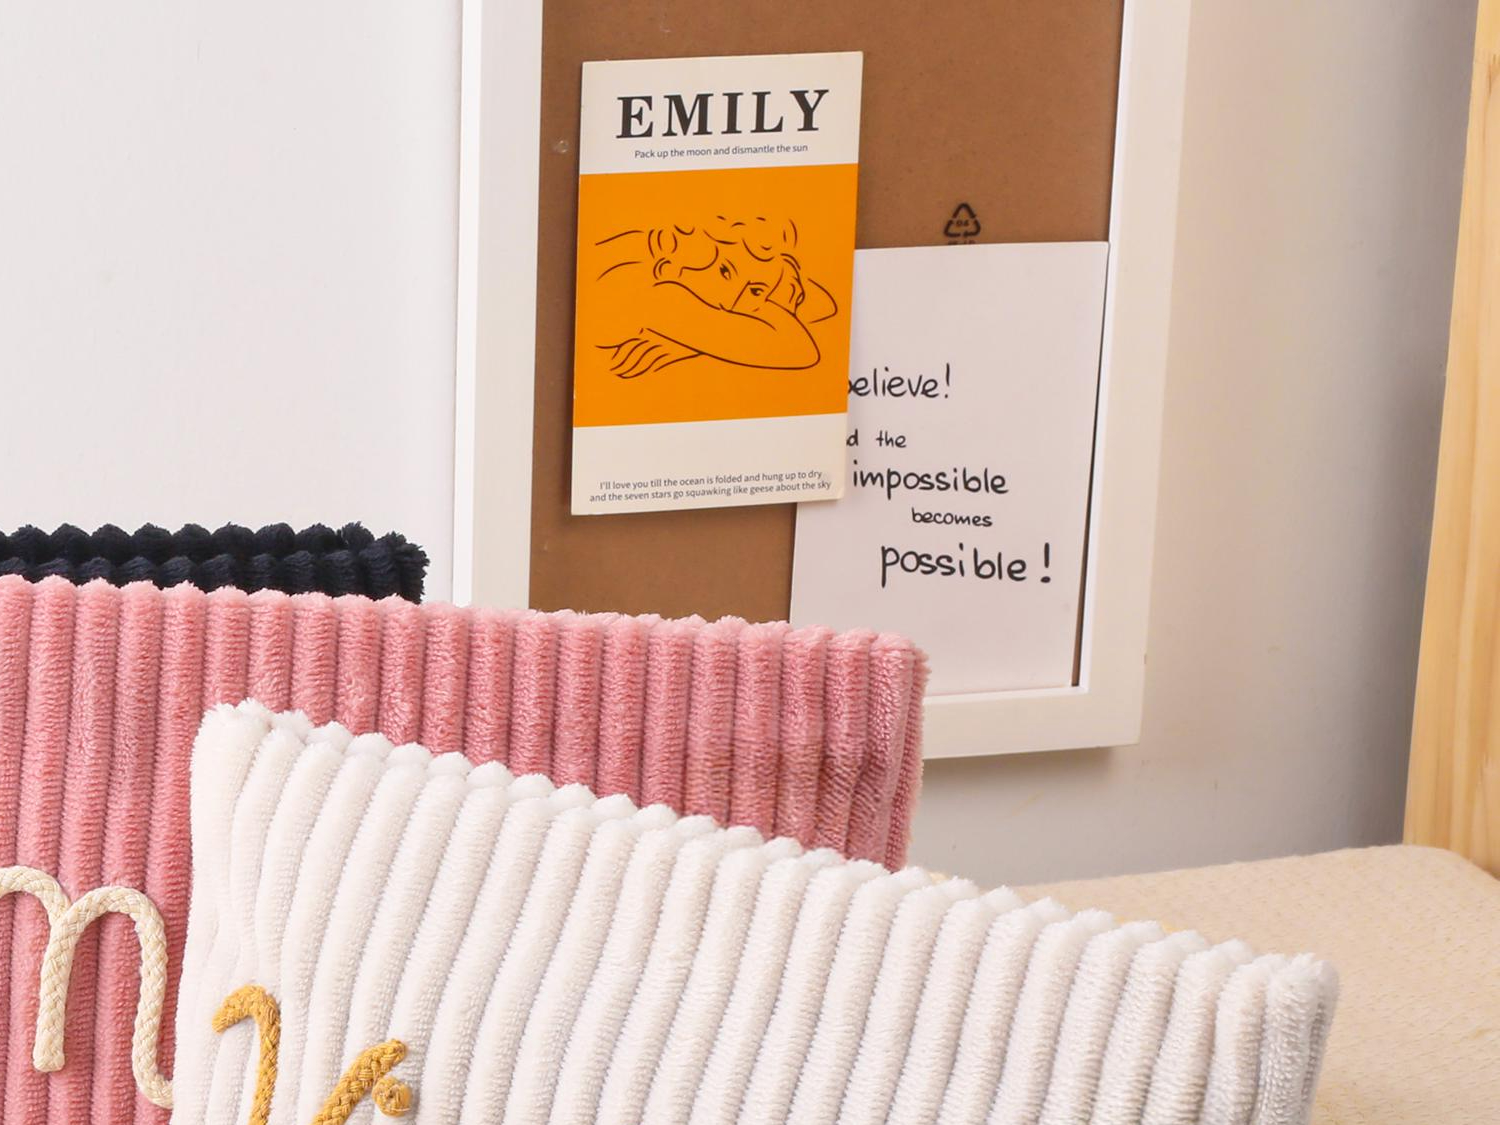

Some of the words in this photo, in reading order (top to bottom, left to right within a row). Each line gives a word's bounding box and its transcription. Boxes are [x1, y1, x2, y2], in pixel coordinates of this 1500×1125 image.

[616, 89, 829, 139] EMILY
[634, 150, 655, 159] Pack
[657, 151, 668, 160] up
[670, 149, 685, 157] the
[686, 148, 712, 157] moon
[713, 146, 730, 156] and
[731, 145, 775, 155] dismantle
[776, 144, 791, 153] the
[792, 144, 808, 152] sun
[876, 430, 907, 448] the
[599, 481, 611, 490] I'll
[612, 480, 631, 489] love
[632, 481, 648, 490] you
[650, 478, 662, 487] till
[663, 478, 678, 487] the
[679, 477, 705, 486] ocean
[706, 475, 714, 484] is
[715, 475, 742, 484] folded
[744, 473, 760, 482] and
[761, 473, 784, 483] hung
[785, 472, 796, 480] up
[797, 471, 807, 479] to
[808, 470, 823, 479] dry
[852, 459, 1009, 500] impossible
[589, 493, 606, 503] and
[608, 492, 624, 501] the
[624, 492, 649, 501] seven
[651, 490, 672, 499] stars
[673, 491, 684, 500] go
[685, 487, 732, 499] squawking
[733, 485, 748, 494] like
[749, 485, 774, 495] geese
[775, 483, 800, 492] about
[802, 481, 816, 490] the
[817, 480, 832, 490] sky
[911, 507, 993, 527] becomes
